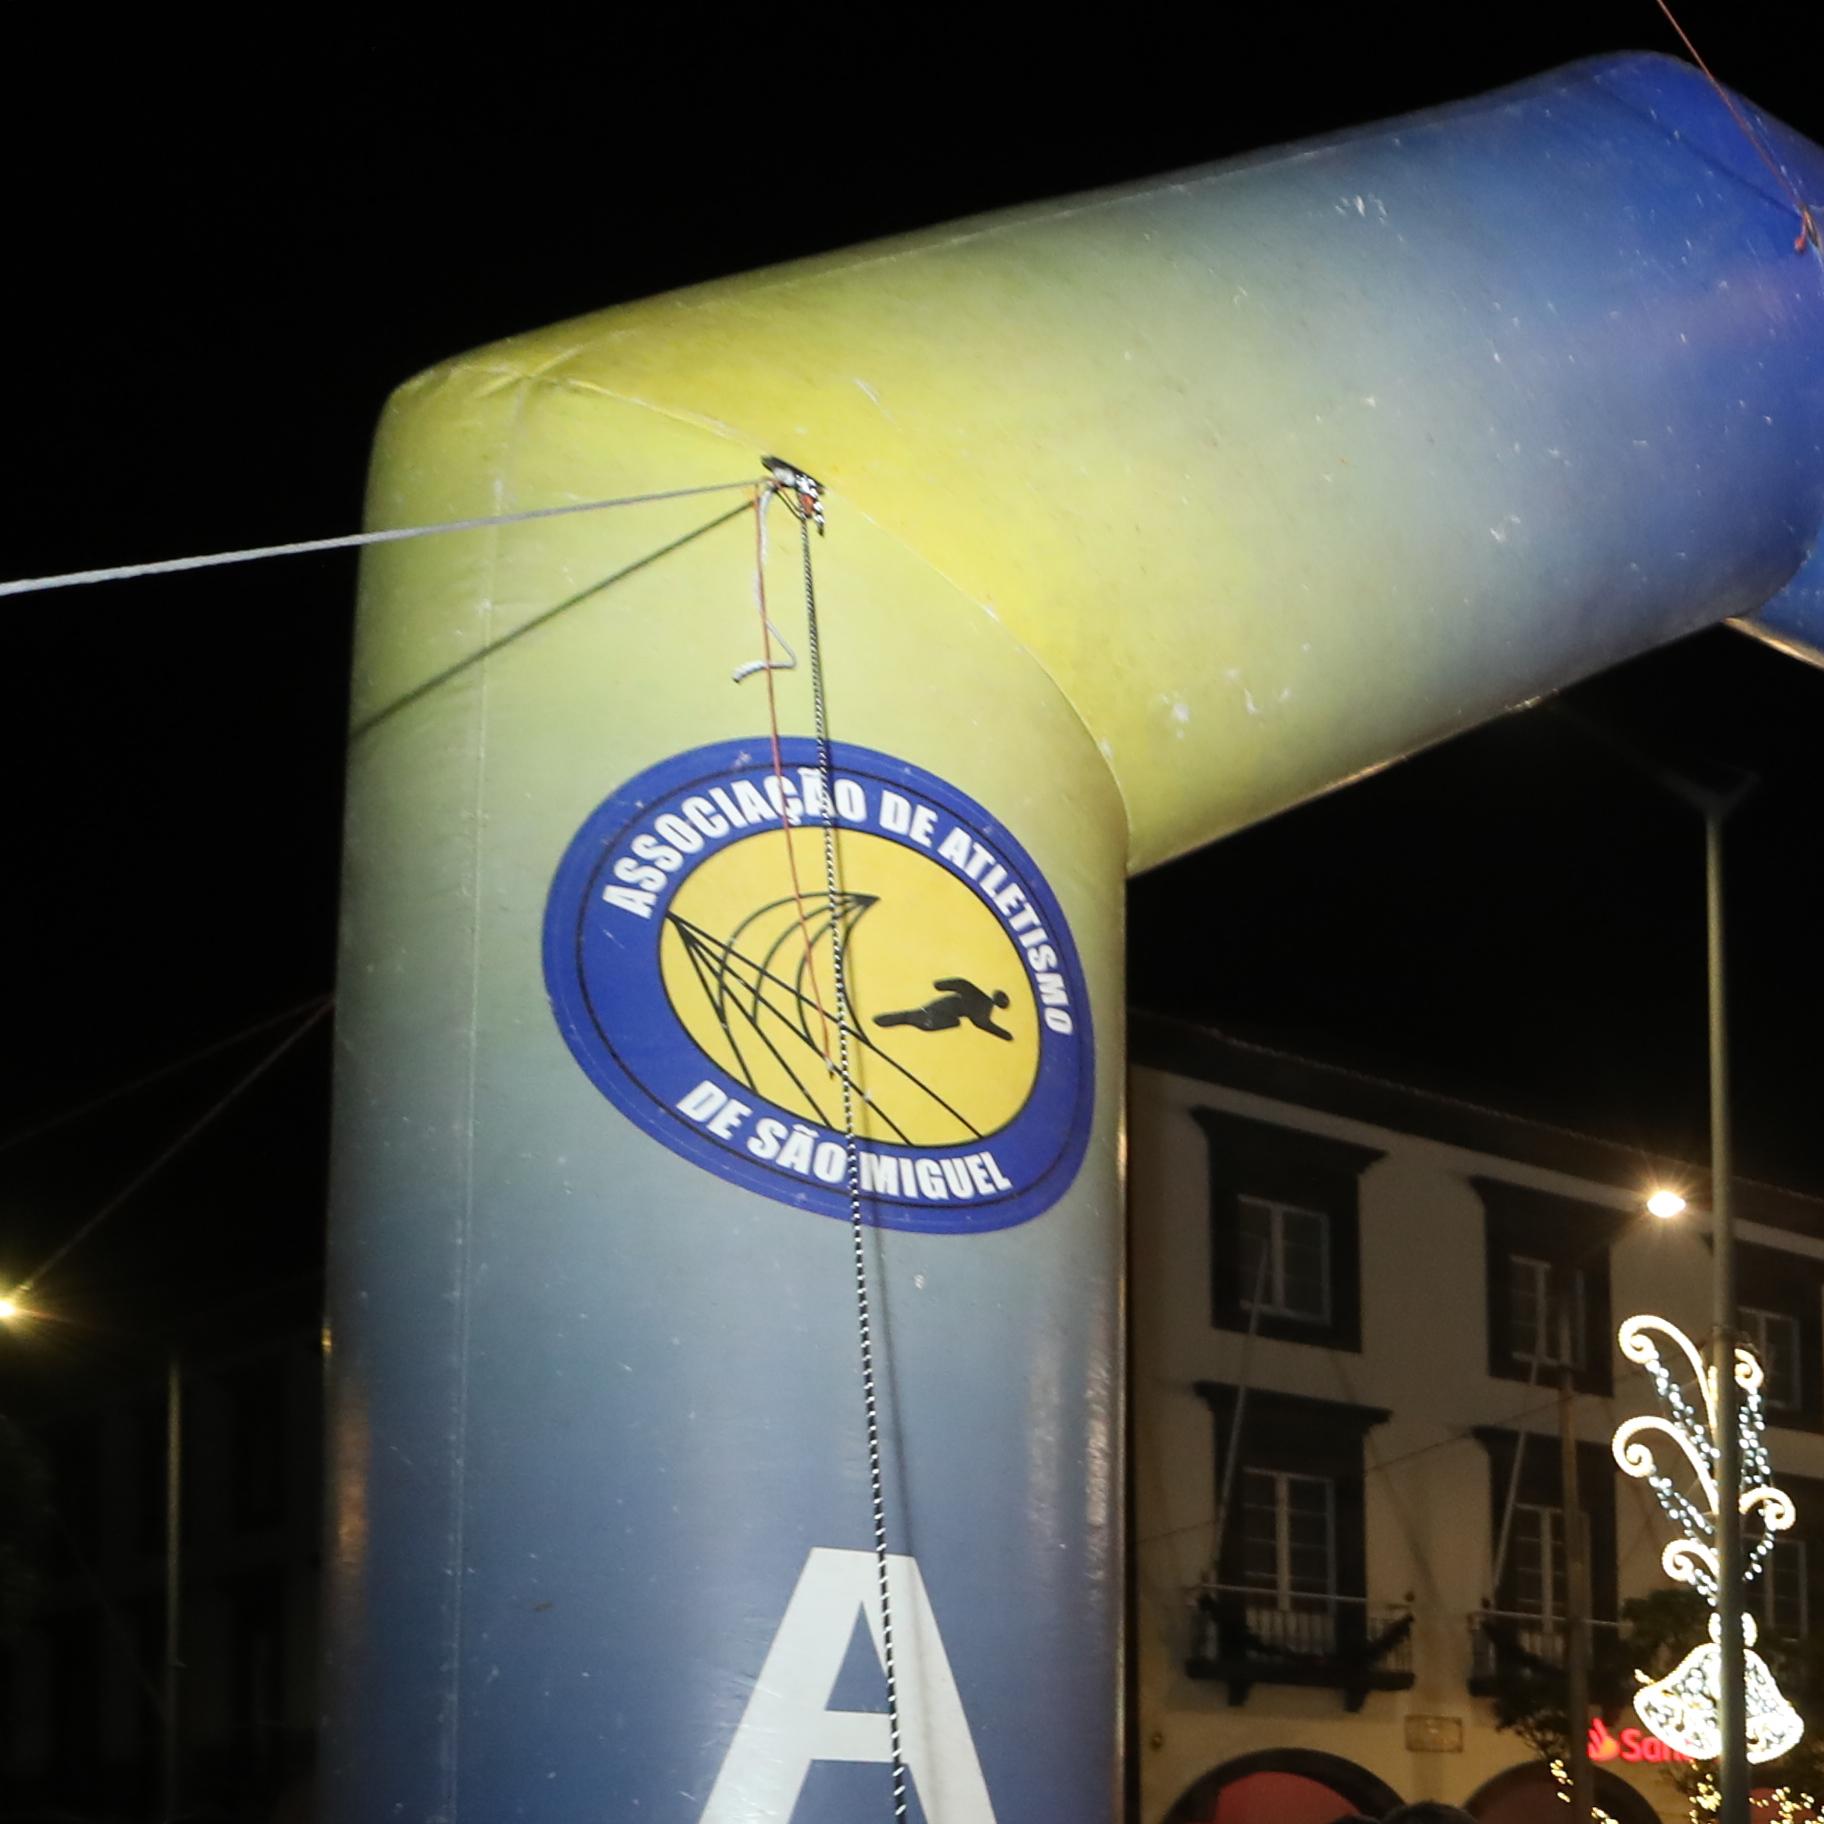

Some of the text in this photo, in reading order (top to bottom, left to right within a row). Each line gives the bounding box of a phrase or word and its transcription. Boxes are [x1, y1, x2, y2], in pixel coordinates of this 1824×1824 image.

[602, 768, 1074, 1038] ASSOCIAÇÃO DE ATLETISMO
[676, 1079, 1012, 1202] DE SÃO MIGUEL
